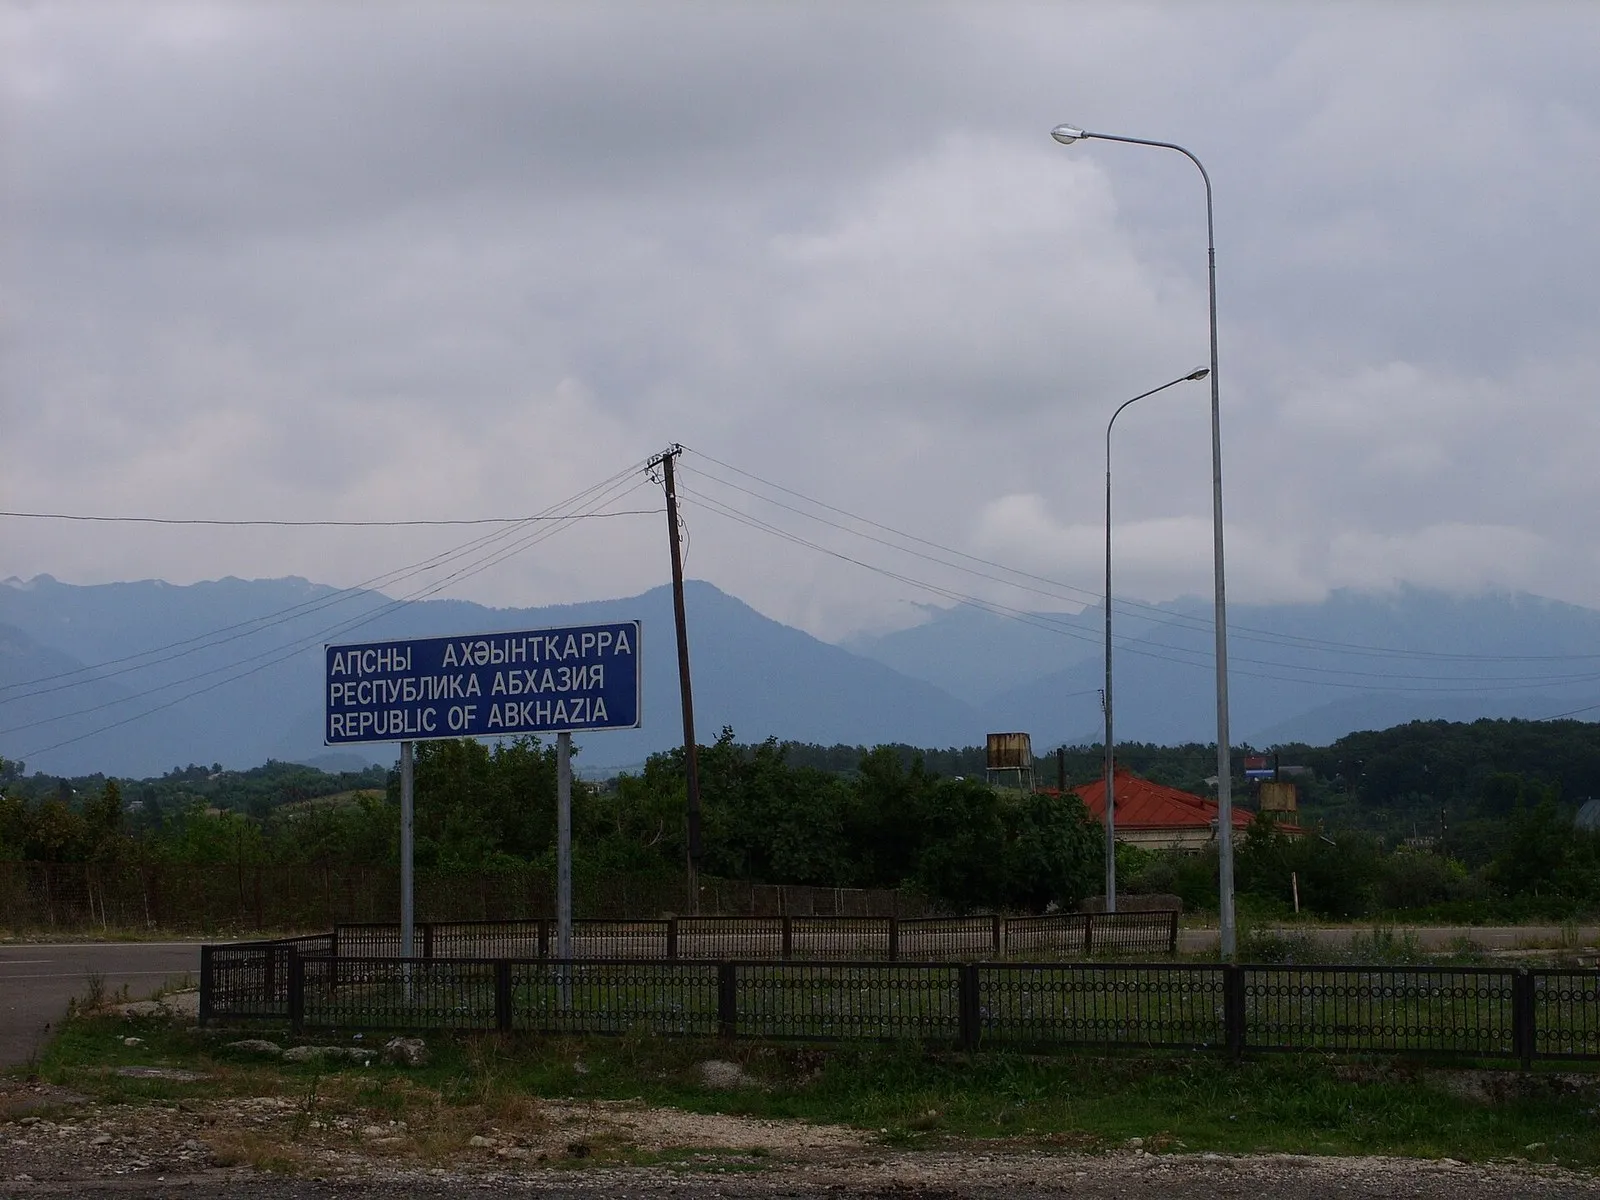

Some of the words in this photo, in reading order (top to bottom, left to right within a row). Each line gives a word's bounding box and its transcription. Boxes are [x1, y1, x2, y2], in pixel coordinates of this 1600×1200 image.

[330, 673, 482, 706] РЕСПУБЛИКА
[491, 664, 604, 696] АБХАЗИЯ
[330, 708, 437, 737] REPUBLIC
[447, 705, 477, 730] OF
[487, 697, 609, 728] ABKHAZIA
